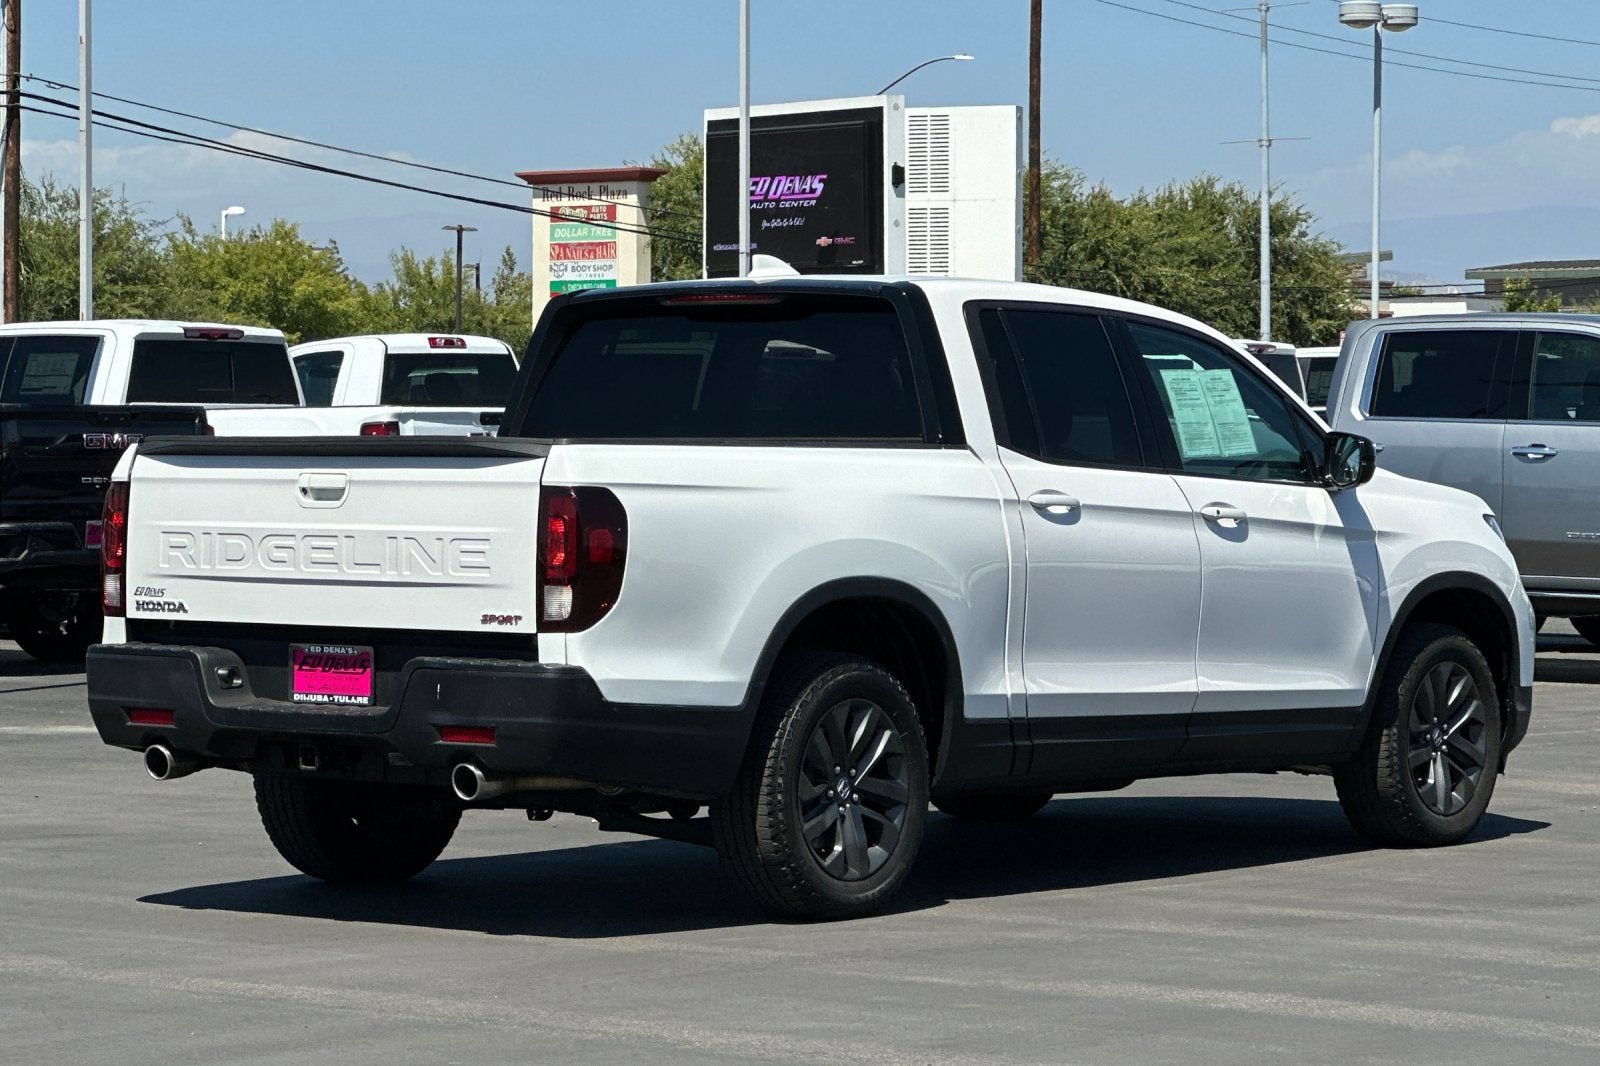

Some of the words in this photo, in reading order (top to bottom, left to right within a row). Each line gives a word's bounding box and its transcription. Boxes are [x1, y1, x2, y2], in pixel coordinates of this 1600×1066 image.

[542, 187, 562, 202] Red
[568, 186, 593, 201] Rock
[599, 184, 628, 200] Plaza
[779, 200, 817, 208] CENTER
[589, 213, 608, 221] PARTS
[554, 227, 589, 238] DOLLAR
[590, 226, 613, 237] TREE
[550, 244, 565, 261] SPA
[566, 247, 589, 260] NAILS
[596, 242, 617, 260] HAIR
[571, 264, 592, 273] BODY
[592, 263, 614, 272] SHOP
[158, 531, 492, 577] RIDGELINE
[135, 600, 189, 614] HONDA
[480, 614, 522, 626] SPORT
[310, 645, 322, 653] ED
[323, 646, 353, 654] DENA'S
[333, 695, 369, 704] TULARE
